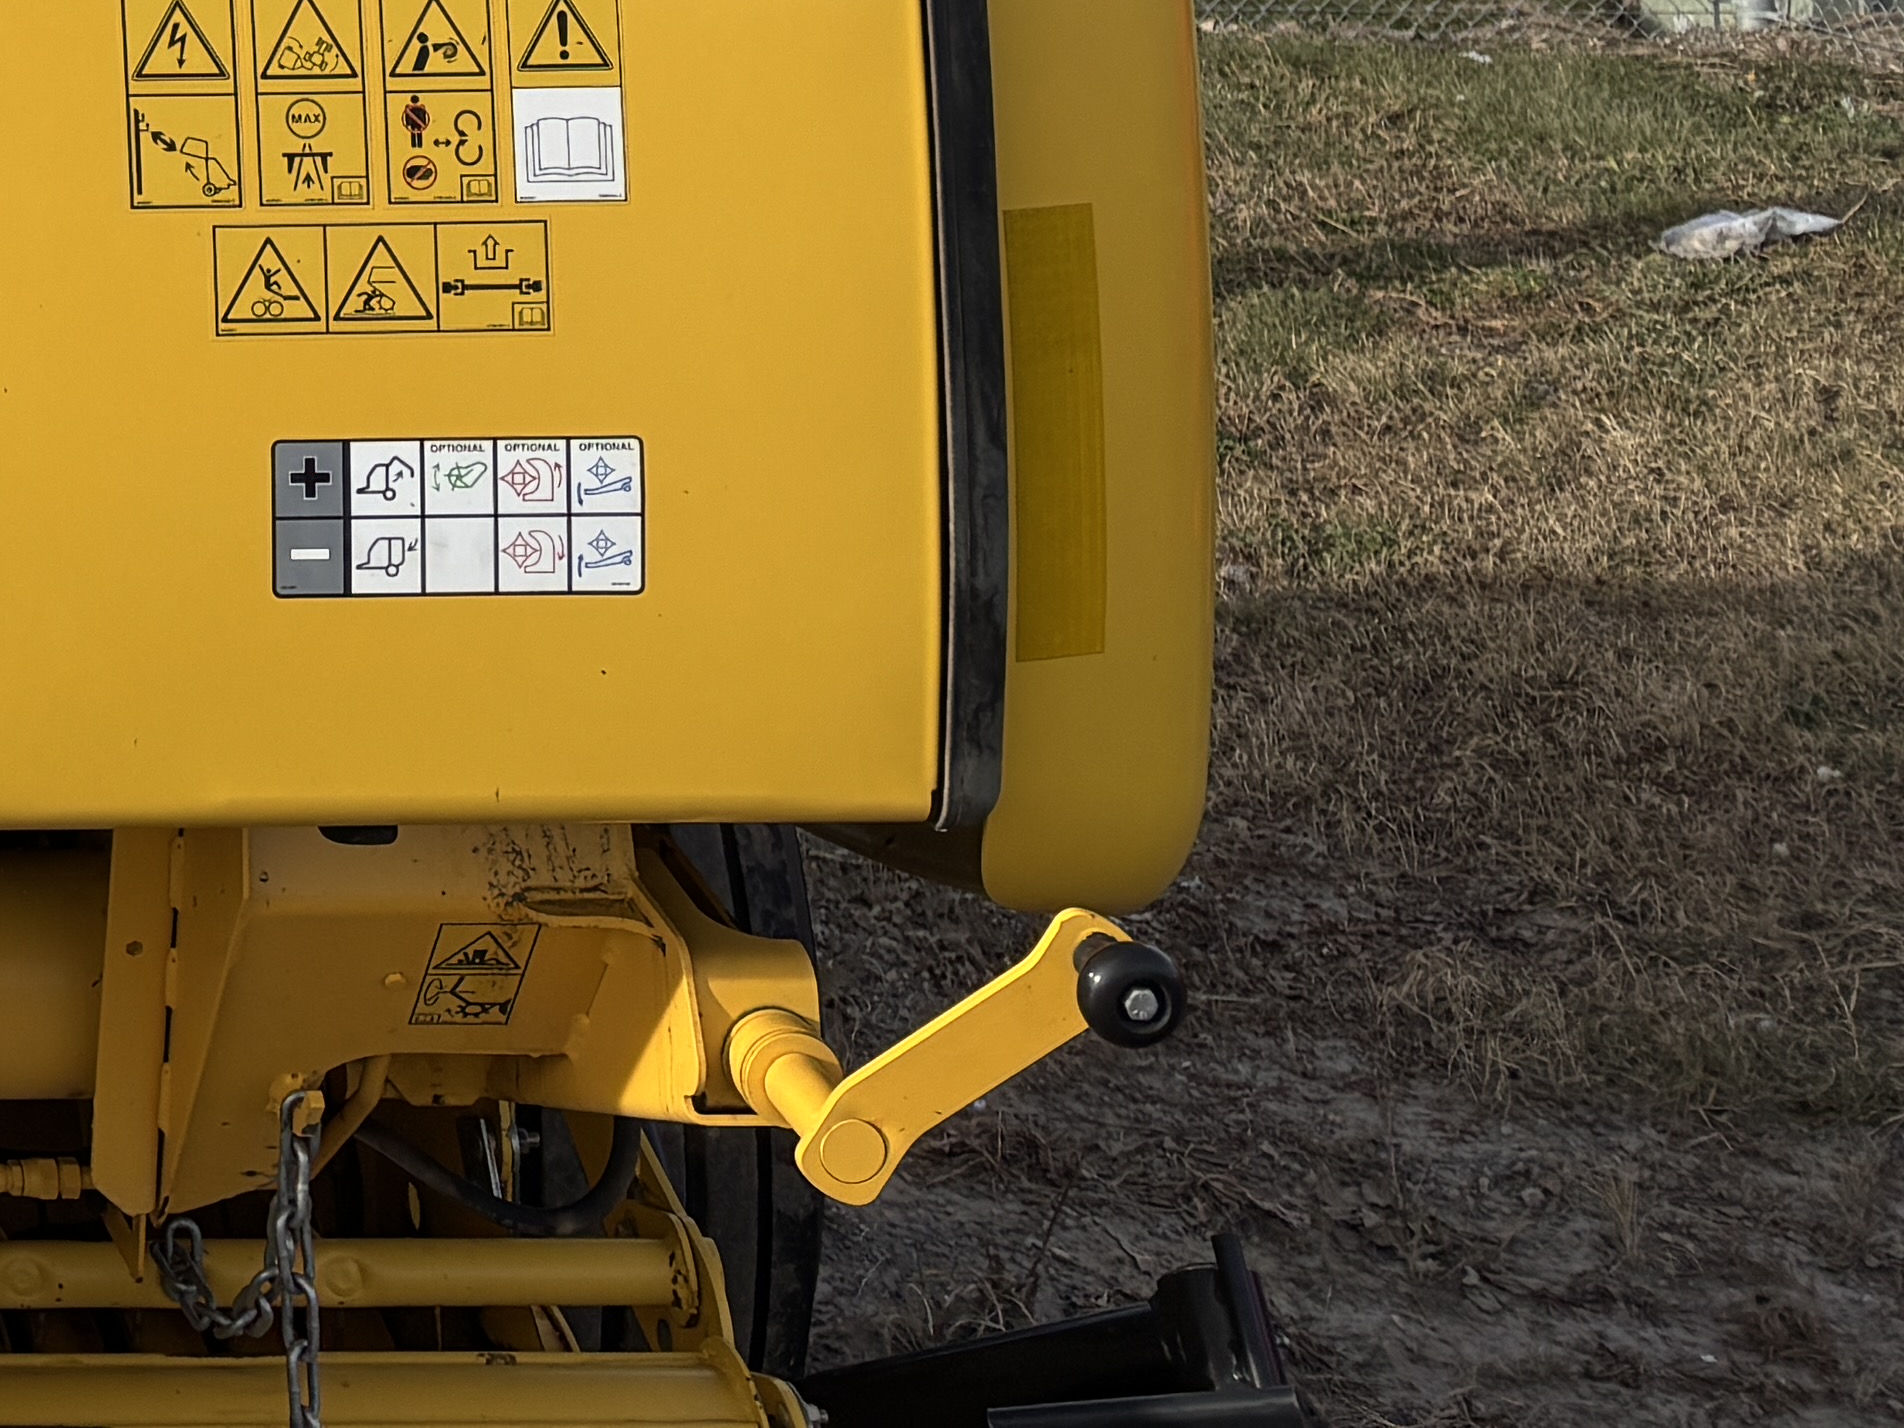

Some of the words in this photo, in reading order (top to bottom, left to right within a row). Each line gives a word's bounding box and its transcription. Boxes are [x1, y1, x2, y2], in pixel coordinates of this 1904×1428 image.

[292, 113, 321, 124] MAX
[430, 443, 485, 453] OPTIONAL
[505, 443, 560, 452] OPTIONAL
[579, 442, 634, 451] OPTIONAL
